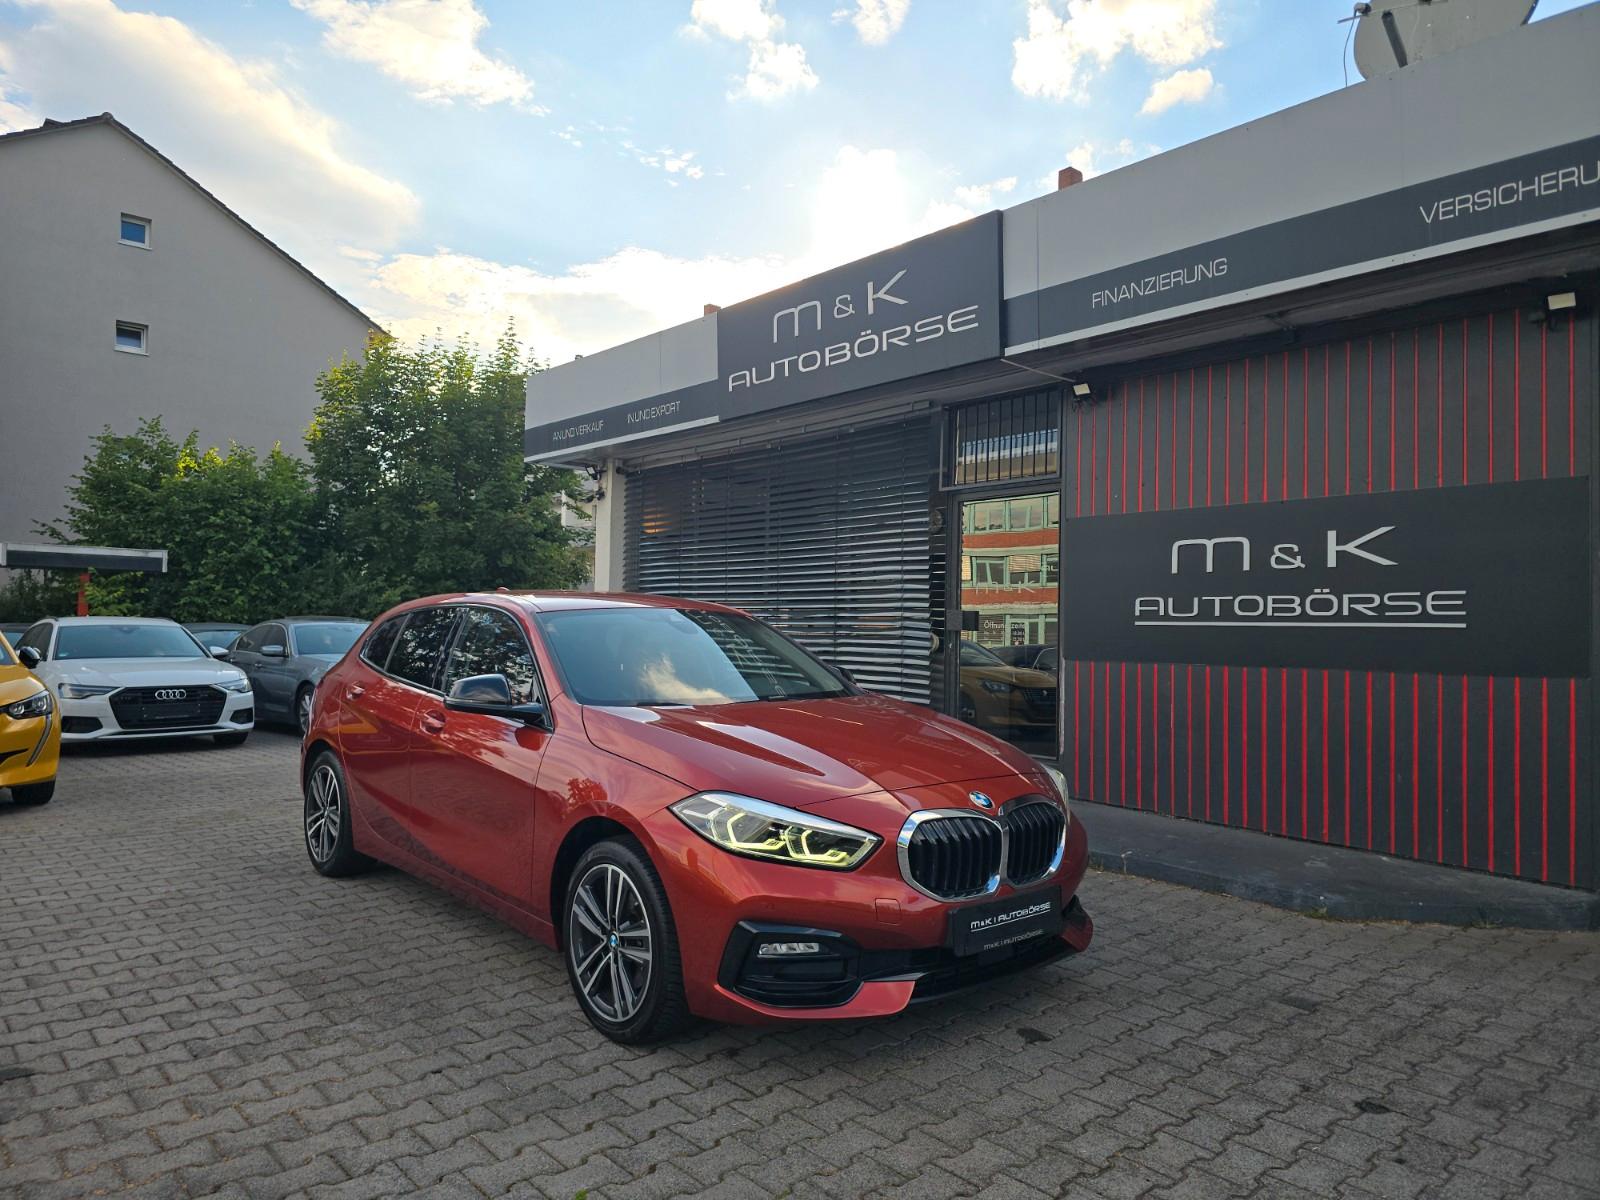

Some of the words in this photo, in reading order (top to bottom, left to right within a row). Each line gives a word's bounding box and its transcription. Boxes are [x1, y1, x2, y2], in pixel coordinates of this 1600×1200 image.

[1420, 160, 1600, 224] VERSICHERU
[773, 300, 822, 343] M
[833, 294, 855, 319] &
[867, 269, 909, 315] K
[1092, 257, 1228, 309] FINANZIERUNG
[728, 304, 979, 392] AUTOBÖRSE
[1171, 536, 1251, 575] M
[1270, 542, 1306, 570] &
[1326, 525, 1398, 568] K
[1134, 588, 1467, 618] AUTOBÖRSE
[997, 901, 1051, 922] AUTOBÖRSE
